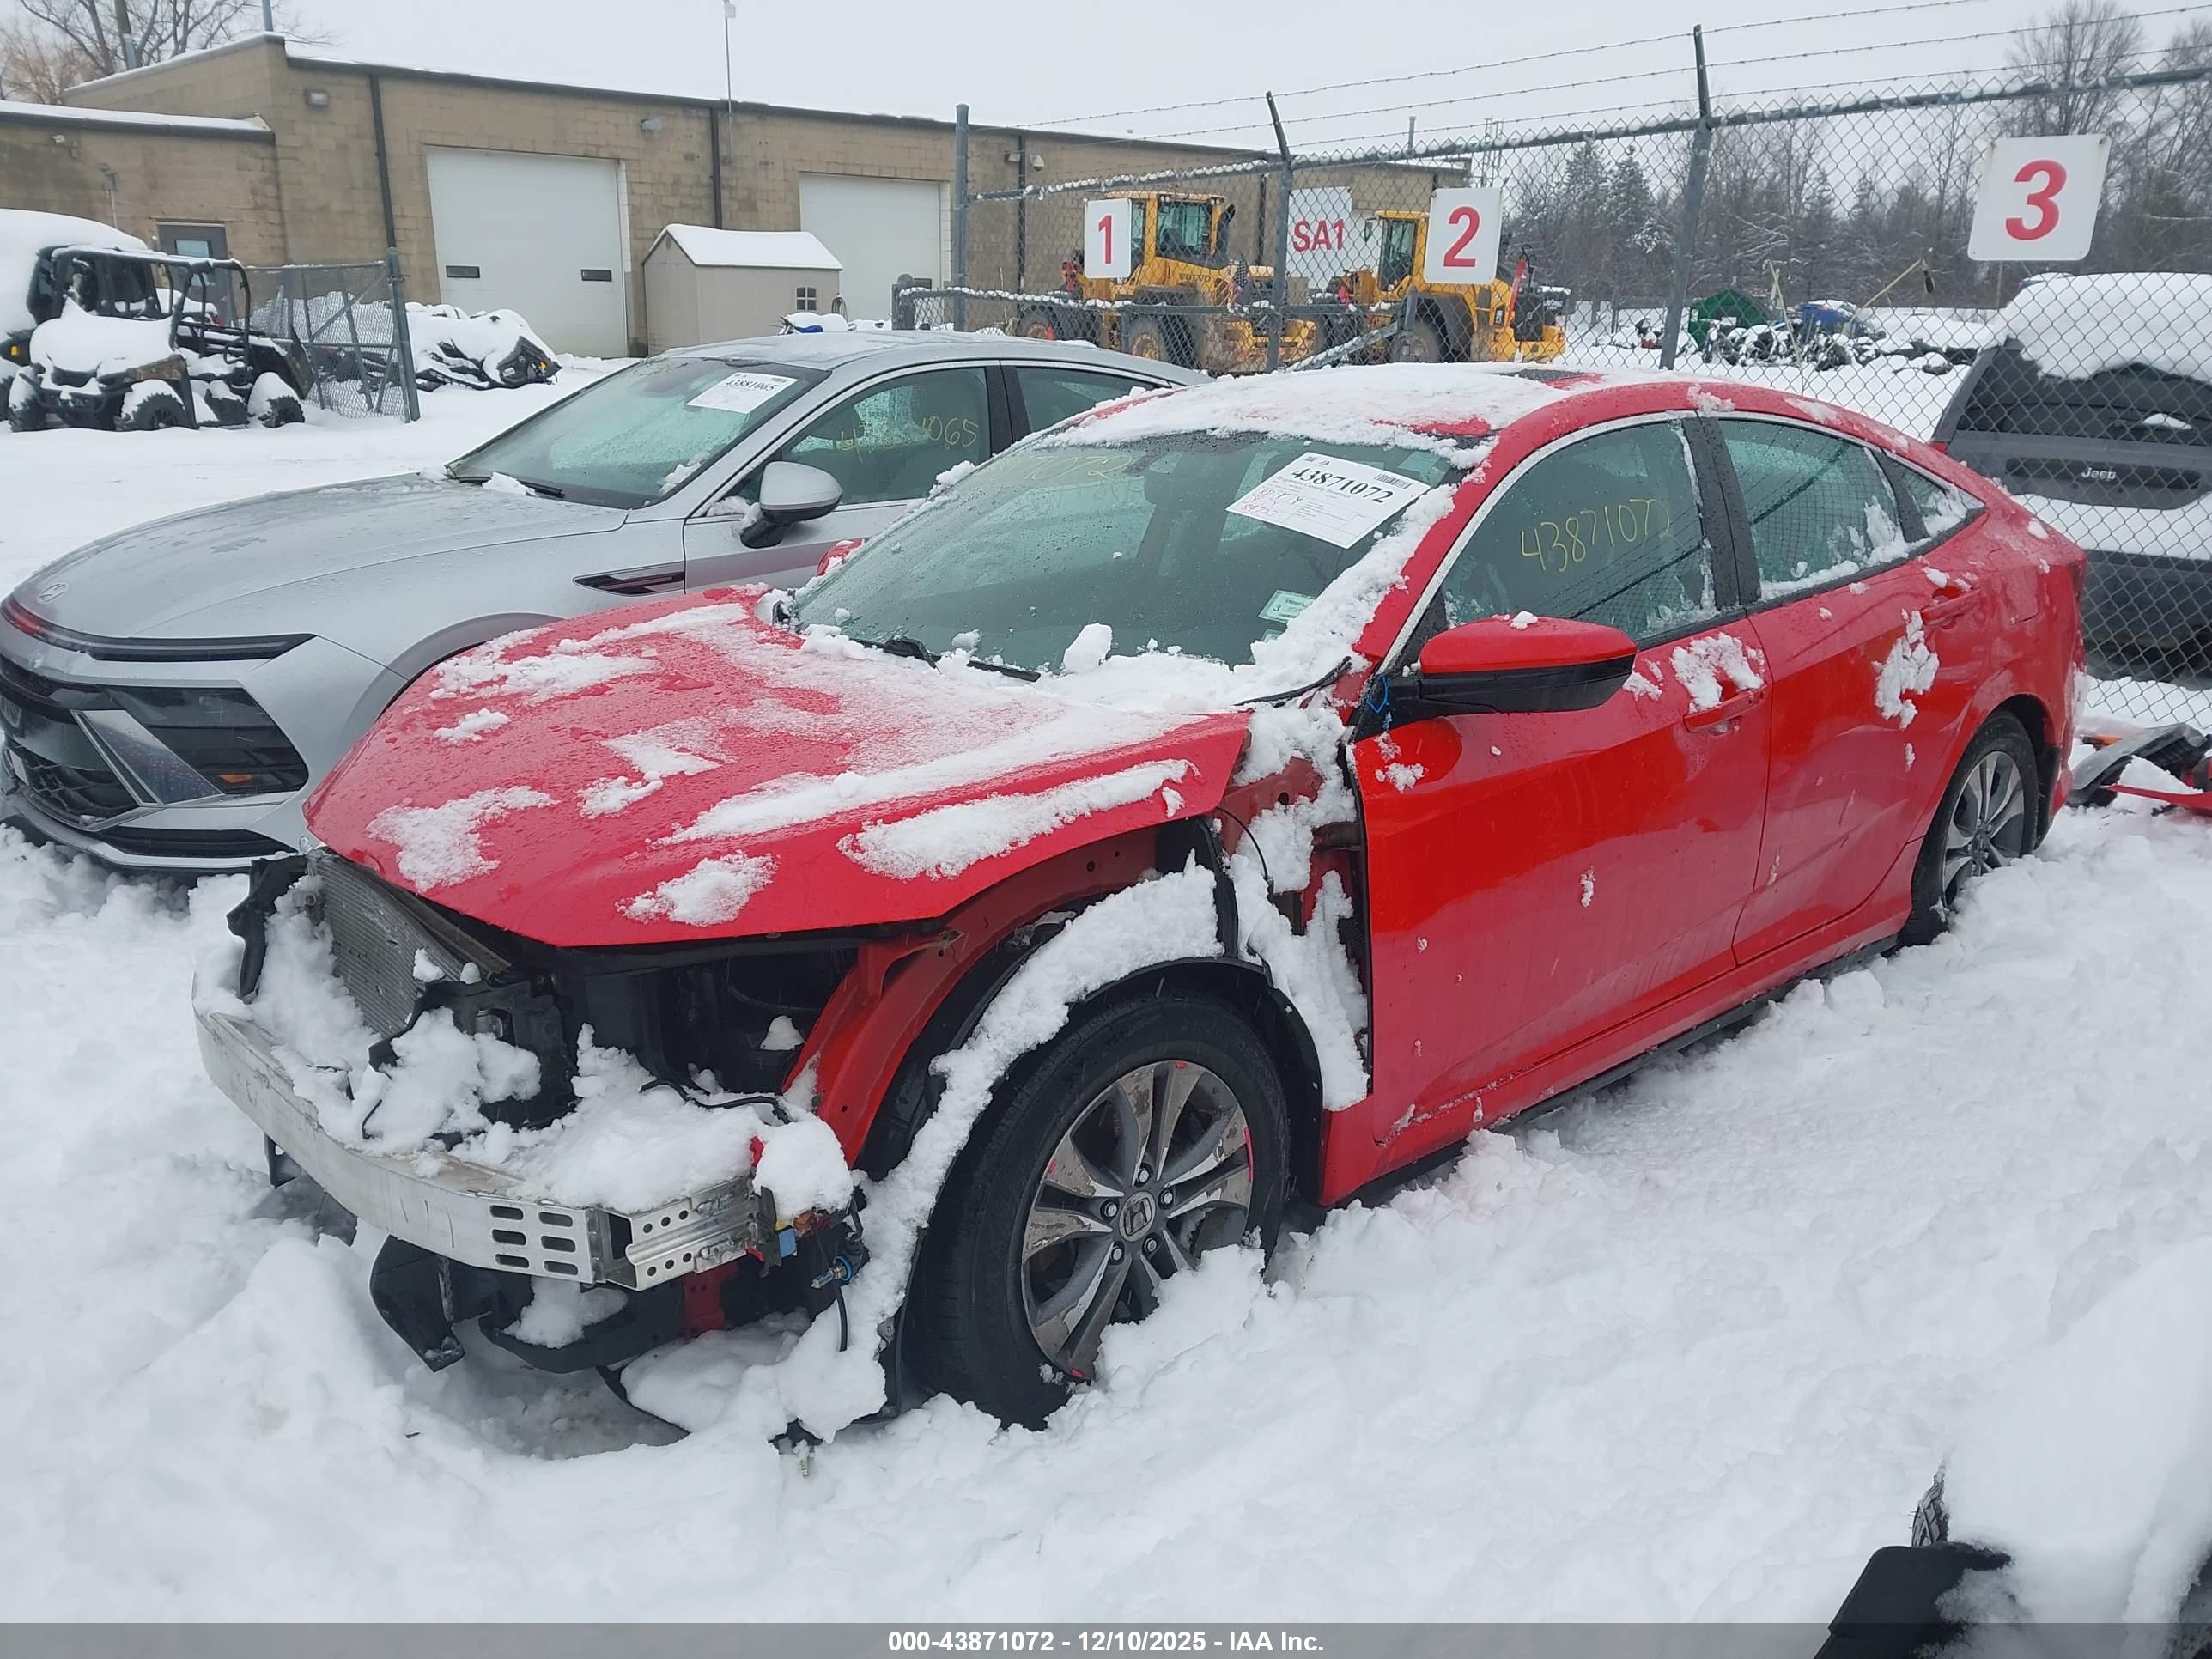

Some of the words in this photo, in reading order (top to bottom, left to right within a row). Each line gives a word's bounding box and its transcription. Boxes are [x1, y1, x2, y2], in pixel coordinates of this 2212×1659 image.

[2005, 160, 2066, 241] 3
[1098, 214, 1113, 264] 1
[1293, 218, 1345, 252] SA1
[1443, 206, 1480, 268] 2
[1179, 273, 1212, 283] VOLVO
[1291, 467, 1395, 504] 43871072
[2081, 466, 2117, 482] Jeep
[1273, 604, 1282, 612] 3
